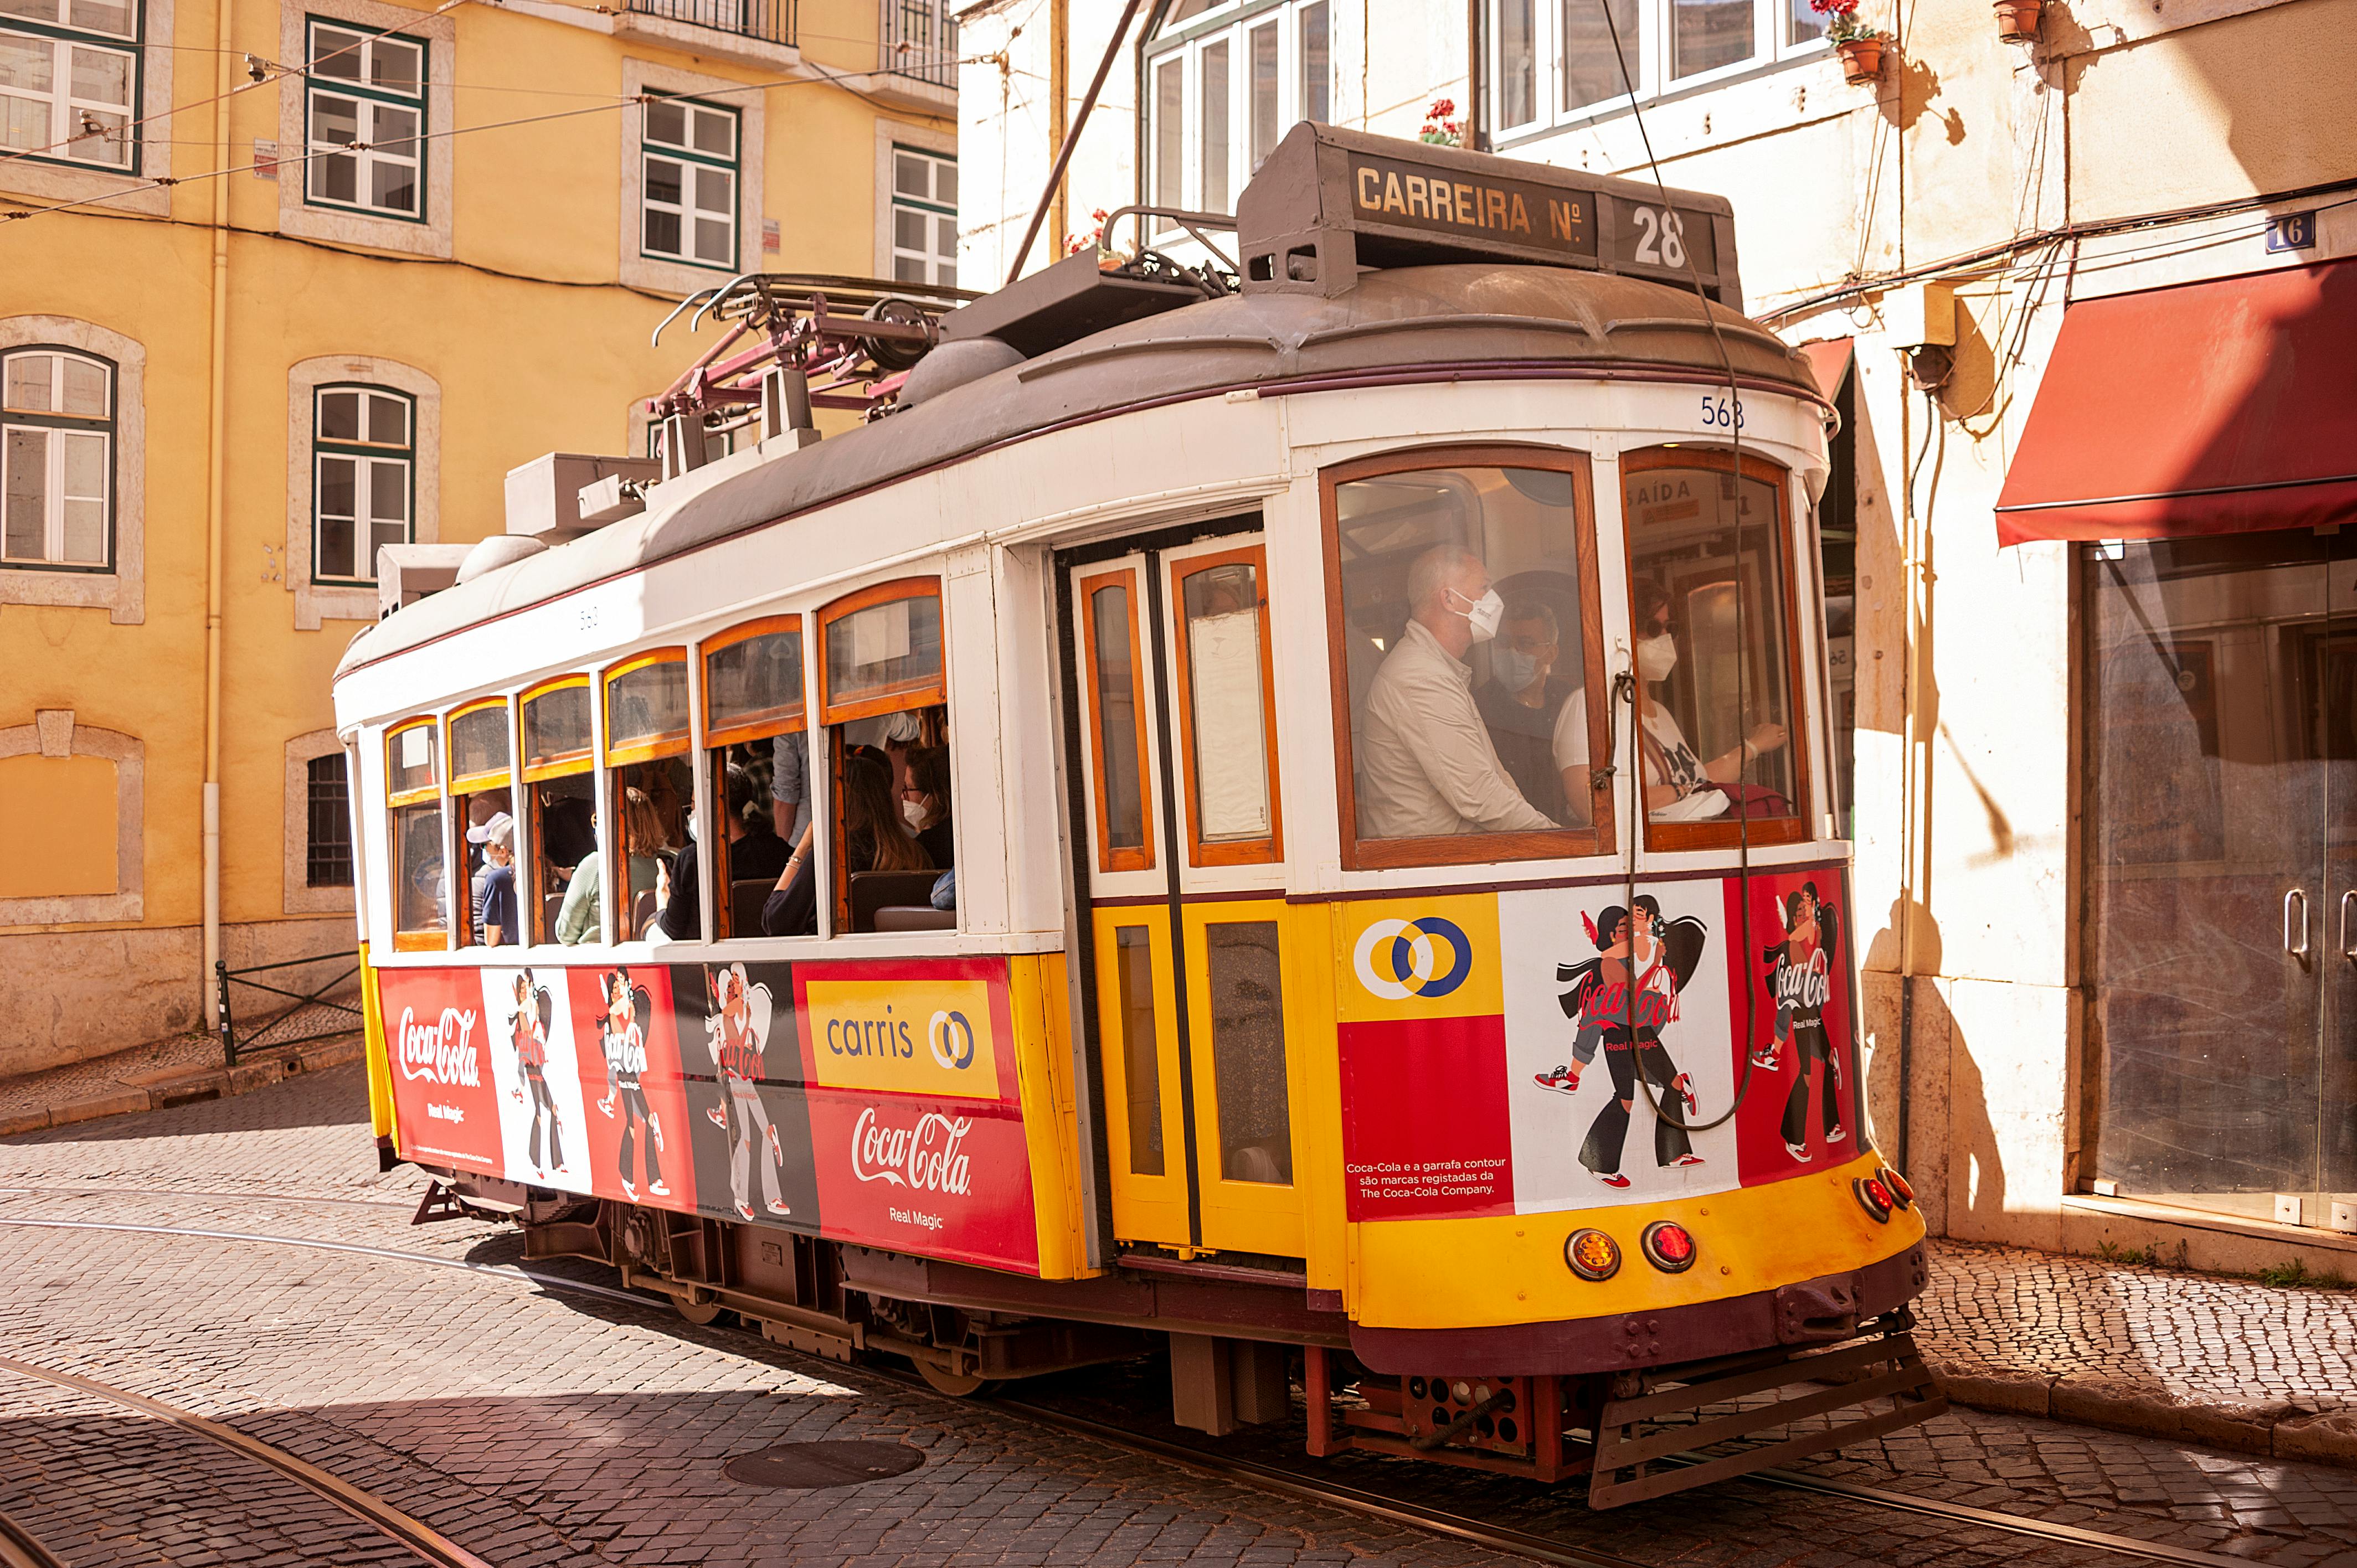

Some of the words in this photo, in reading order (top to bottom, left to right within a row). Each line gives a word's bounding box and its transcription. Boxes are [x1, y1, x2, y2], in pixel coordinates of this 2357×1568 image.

[1358, 167, 1531, 234] CARREIRA
[1634, 206, 1685, 268] 28
[2274, 218, 2303, 246] 16
[1702, 396, 1744, 429] 563
[1578, 965, 1680, 1031] CocaCola
[827, 1004, 913, 1058] carris
[1793, 1020, 1806, 1030] Real
[1806, 1017, 1821, 1028] Magic
[399, 1006, 481, 1087] Coca-Cola
[1606, 1042, 1628, 1051] Real
[1630, 1039, 1658, 1050] agic
[851, 1107, 973, 1195] Coca-Cola
[1346, 1162, 1401, 1173] Coca-Cola
[1423, 1159, 1461, 1172] garrafa
[1464, 1158, 1506, 1169] contour
[1360, 1175, 1378, 1185] são
[1381, 1175, 1419, 1184] marcas
[1422, 1172, 1477, 1185] registadas
[1480, 1171, 1494, 1180] da
[1361, 1189, 1380, 1198] The
[1383, 1187, 1438, 1198] Coca-Cola
[1441, 1184, 1495, 1196] Company.
[889, 1207, 912, 1224] Real
[913, 1210, 944, 1230] Magic
